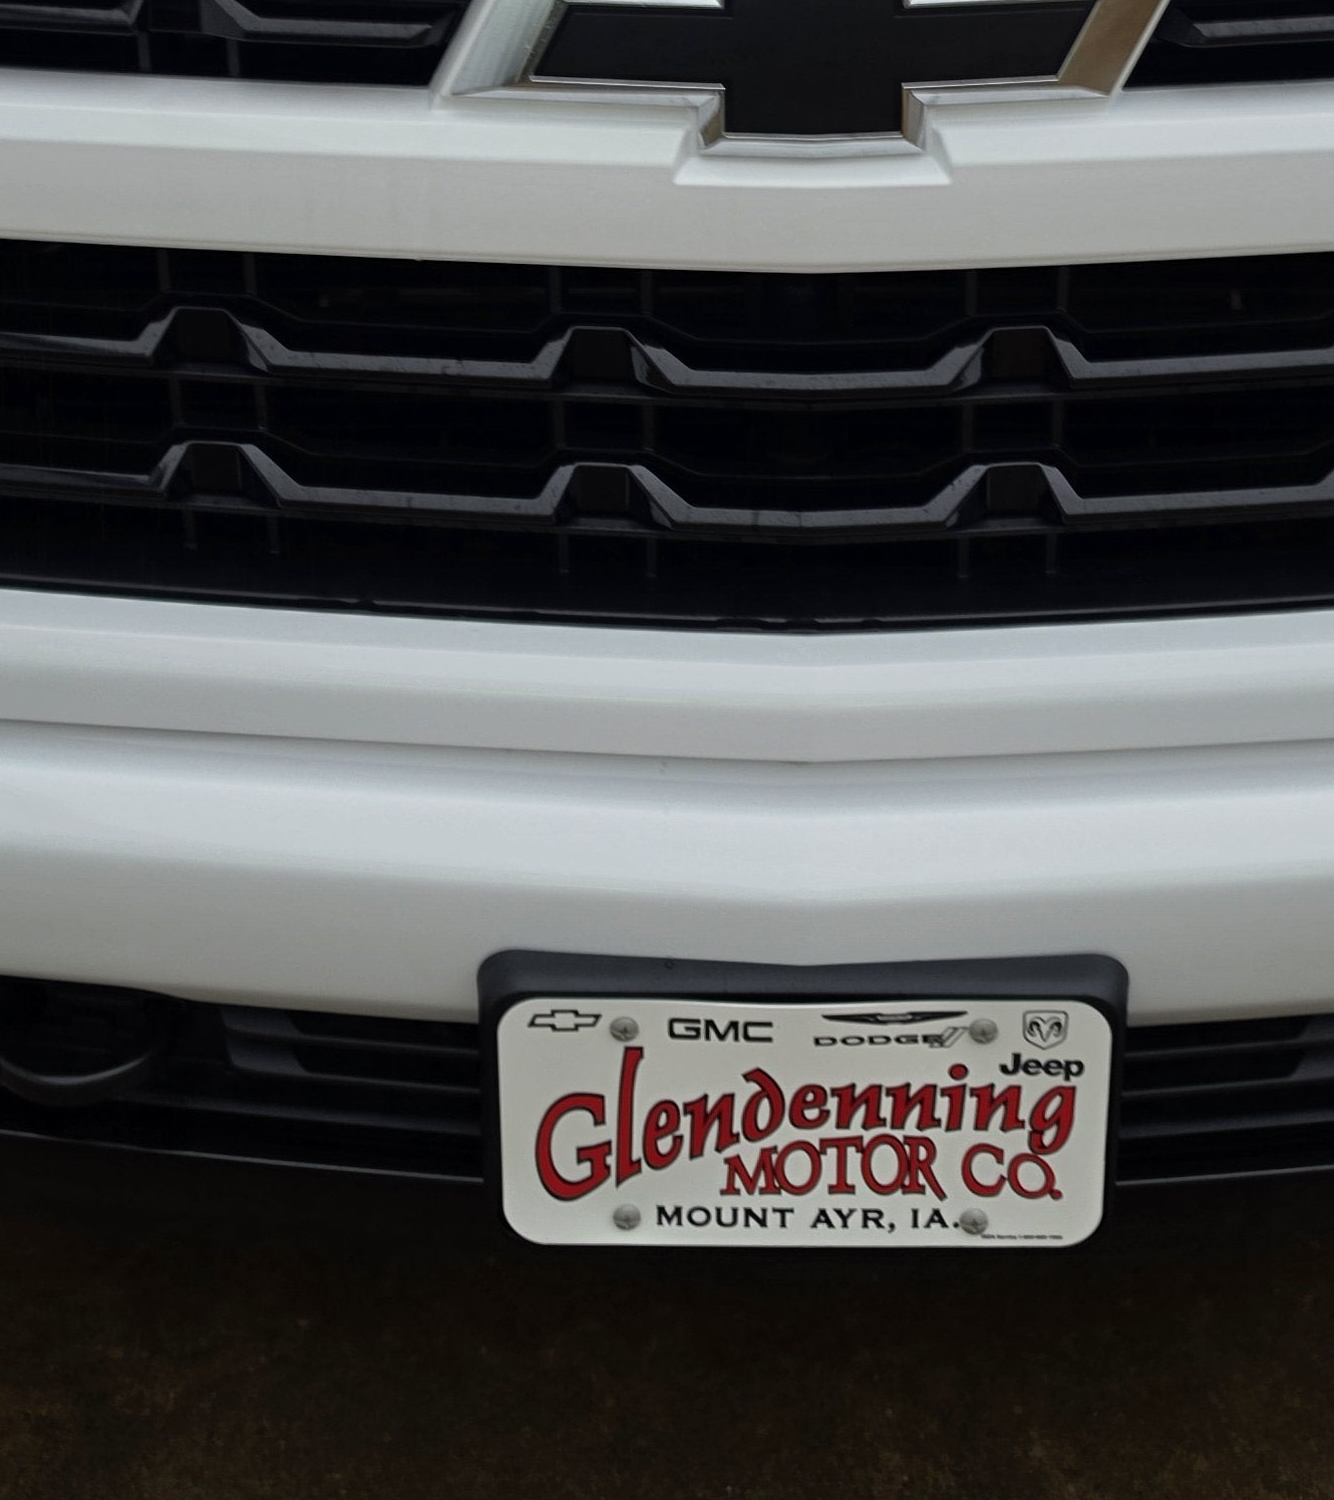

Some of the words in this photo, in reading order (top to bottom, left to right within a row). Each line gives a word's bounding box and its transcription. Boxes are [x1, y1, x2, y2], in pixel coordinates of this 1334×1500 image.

[668, 1017, 774, 1043] GMC
[814, 1034, 945, 1047] DODGE
[999, 1053, 1085, 1081] Jeep
[535, 1046, 1077, 1202] Glendenning
[720, 1134, 948, 1202] MOTOR
[962, 1143, 1064, 1201] CO.
[655, 1205, 794, 1229] MOUNT
[810, 1208, 897, 1234] AYR,
[911, 1208, 960, 1232] IA.
